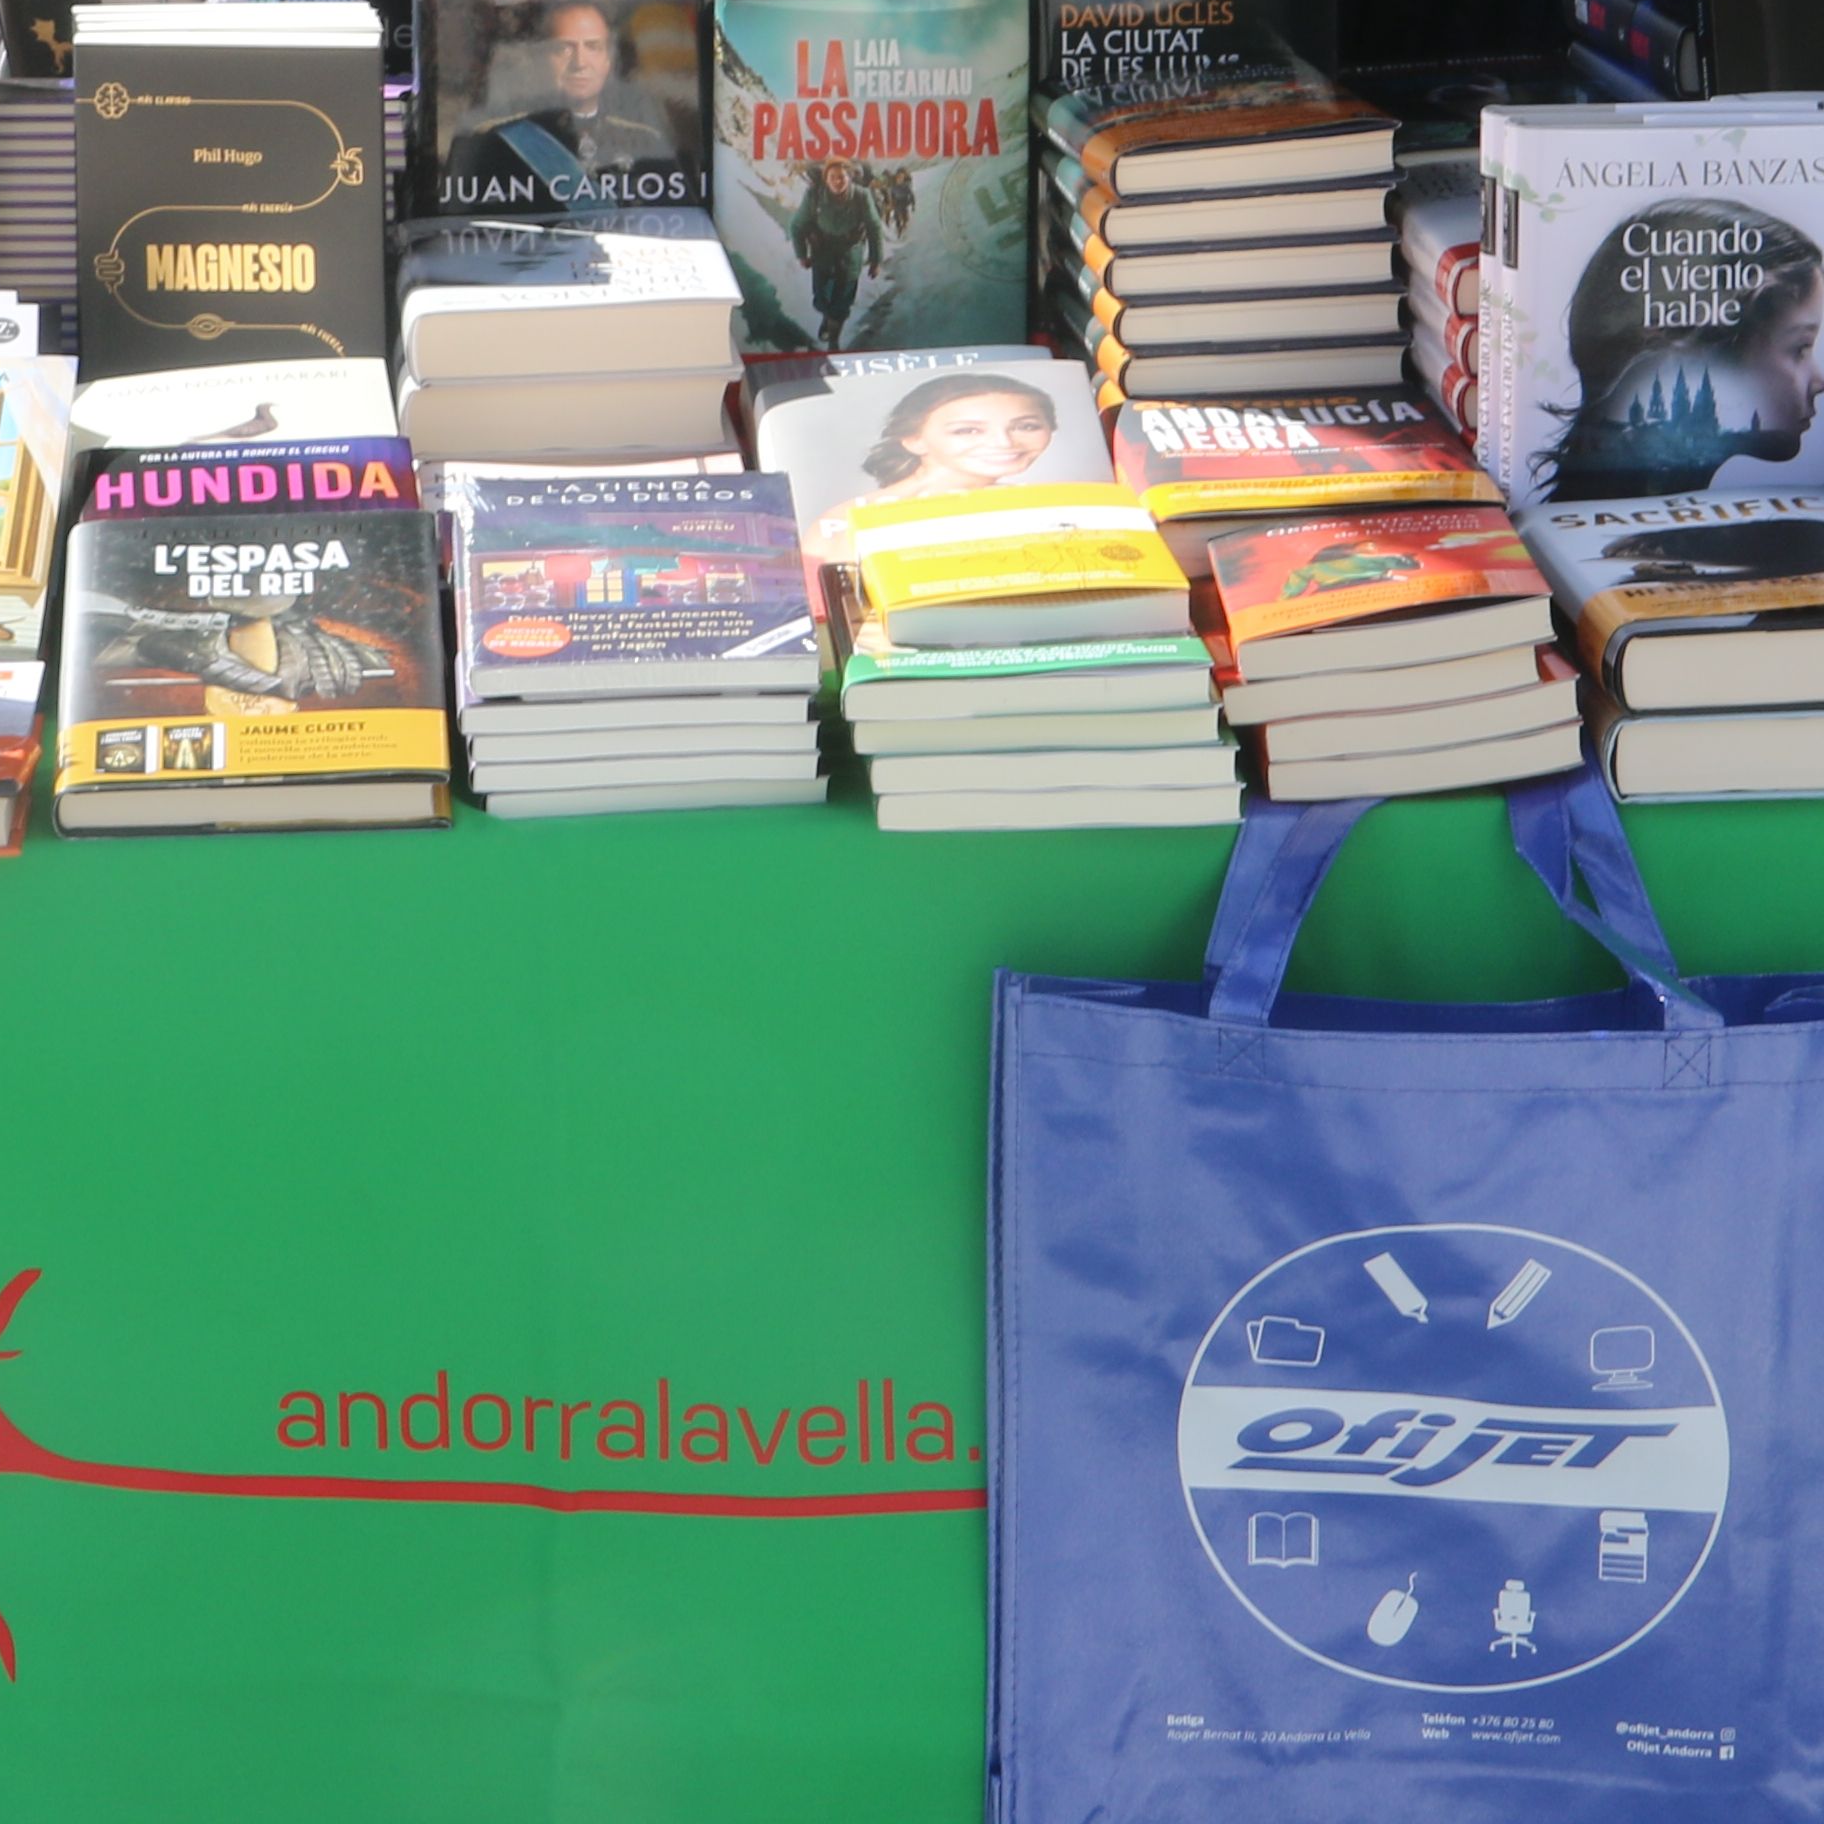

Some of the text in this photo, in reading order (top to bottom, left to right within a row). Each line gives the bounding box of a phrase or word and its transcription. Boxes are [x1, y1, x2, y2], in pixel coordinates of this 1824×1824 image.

[1060, 2, 1144, 28] DAVID
[853, 38, 900, 68] LAIA
[1061, 28, 1204, 55] LA CIUTAT
[796, 39, 849, 98] LA
[853, 68, 972, 98] PEREARNAU
[752, 98, 1000, 161] PASSADORA
[194, 149, 263, 166] Phil Hugo
[1555, 159, 1694, 188] ÁNGELA
[439, 173, 707, 203] JUAN CARLOS I
[1623, 220, 1764, 257] Cuando
[146, 243, 316, 293] MAGNESIO
[1620, 257, 1766, 293] el viento
[1642, 291, 1742, 328] hable
[1141, 399, 1425, 433] ANDALUCÍA
[1147, 424, 1322, 453] NEGRA
[139, 443, 350, 463] POR LA AUTORA DE ROMPER EL CÍRCULO
[95, 461, 400, 511] HUNDIDA
[507, 489, 756, 505] DE LOS DESEOS
[547, 480, 713, 494] LA TIENDA
[1663, 495, 1707, 508] EL
[154, 540, 351, 575] L'ESPASA
[189, 571, 314, 599] DEL REI
[568, 612, 613, 621] llevar
[619, 612, 646, 621] por
[651, 610, 667, 619] el
[240, 721, 367, 736] JAUME CLOTET
[1167, 1714, 1205, 1727] Botiga
[1421, 1712, 1465, 1725] Telèfon
[1503, 1717, 1518, 1728] 80
[1538, 1718, 1554, 1729] 80
[1616, 1722, 1715, 1742] @ofijet_andorra
[1167, 1729, 1201, 1742] Roger
[1203, 1729, 1243, 1742] Bernat
[1261, 1731, 1277, 1743] 20
[1278, 1730, 1325, 1743] Andorra
[1327, 1729, 1341, 1742] La
[1344, 1729, 1371, 1742] Vella
[1421, 1728, 1561, 1744] Web www.ofijet.com
[1626, 1739, 1713, 1759] Ofijet Andorra
